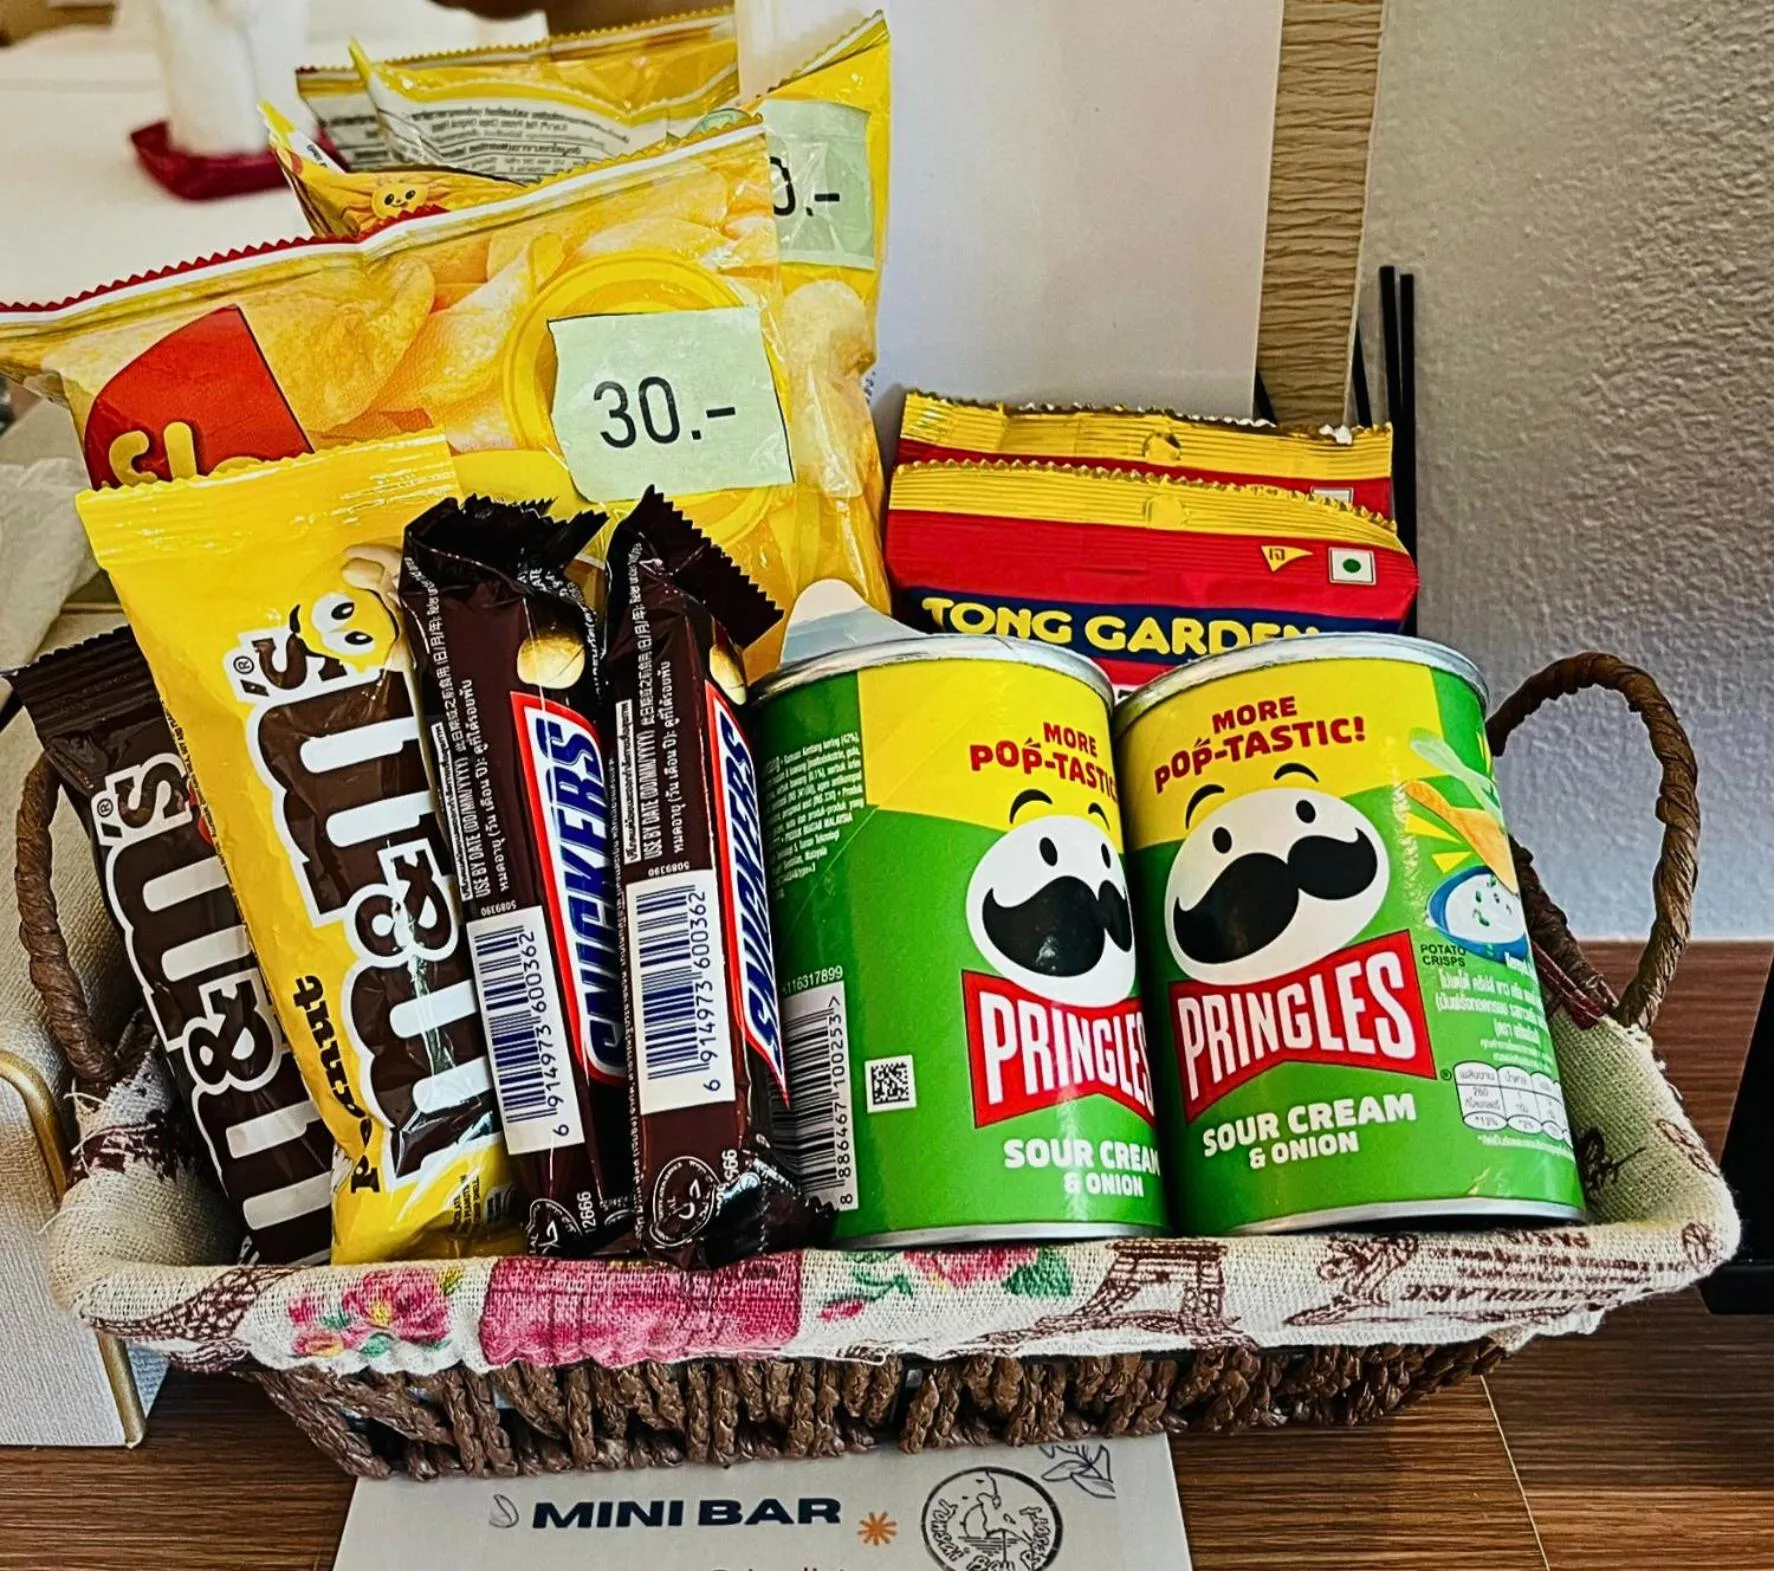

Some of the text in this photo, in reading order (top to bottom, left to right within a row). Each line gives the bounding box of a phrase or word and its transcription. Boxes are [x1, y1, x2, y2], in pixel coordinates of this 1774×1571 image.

[593, 376, 737, 448] 30.-
[922, 597, 1071, 645] TONG
[1211, 696, 1297, 734] MORE
[1043, 722, 1098, 757] MORE
[641, 799, 659, 822] DATE
[469, 834, 485, 860] DATE
[642, 825, 660, 839] BY
[642, 840, 662, 859] USE
[474, 862, 488, 877] BY
[475, 879, 491, 898] USE
[1420, 944, 1467, 958] POTATO
[1422, 955, 1466, 968] CRISPS
[690, 890, 721, 1093] 6 914973 600362
[523, 931, 570, 1137] 6 914973 600362
[1177, 951, 1418, 1103] PRINGLES
[829, 1014, 853, 1205] 8 886467 100253
[1203, 1092, 1417, 1158] SOUR CREAM
[1003, 1139, 1095, 1170] SOUR
[1249, 1131, 1360, 1170] & ONION
[1088, 1176, 1144, 1198] ONION
[532, 1498, 842, 1529] MINI BAR
